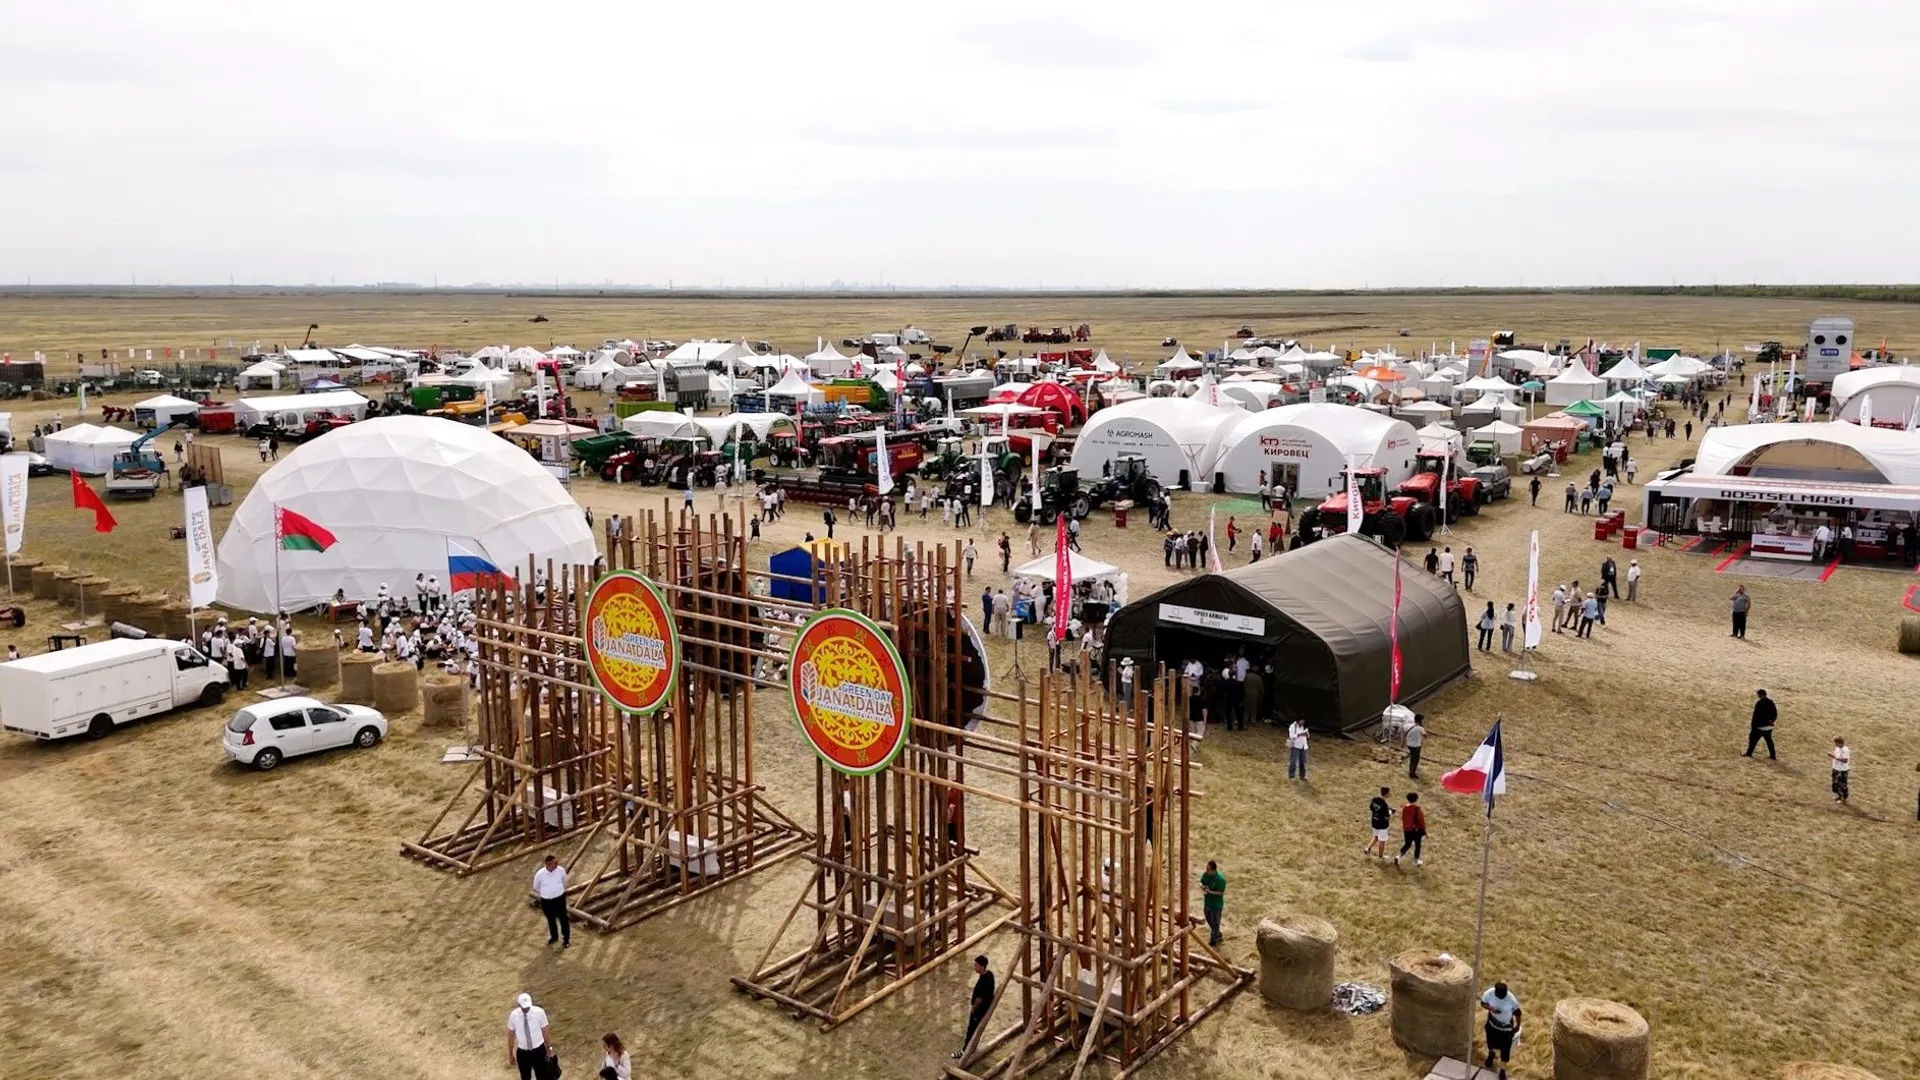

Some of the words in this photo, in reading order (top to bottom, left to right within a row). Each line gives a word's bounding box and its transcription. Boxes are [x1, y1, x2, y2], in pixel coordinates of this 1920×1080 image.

[1115, 430, 1153, 438] AGROMASH
[1264, 448, 1309, 459] КИРОВЕЦ
[1351, 473, 1360, 520] КИРОВ
[1721, 490, 1854, 505] ROSTSELMASH
[196, 510, 207, 540] DALA
[201, 542, 210, 570] JANA
[605, 640, 632, 656] JANA
[636, 645, 664, 661] DALA
[625, 634, 648, 646] GREEN
[650, 639, 663, 649] DAY
[842, 683, 872, 698] GREEN
[874, 690, 892, 702] DAY
[816, 688, 852, 708] JANA
[856, 696, 893, 718] DALA
